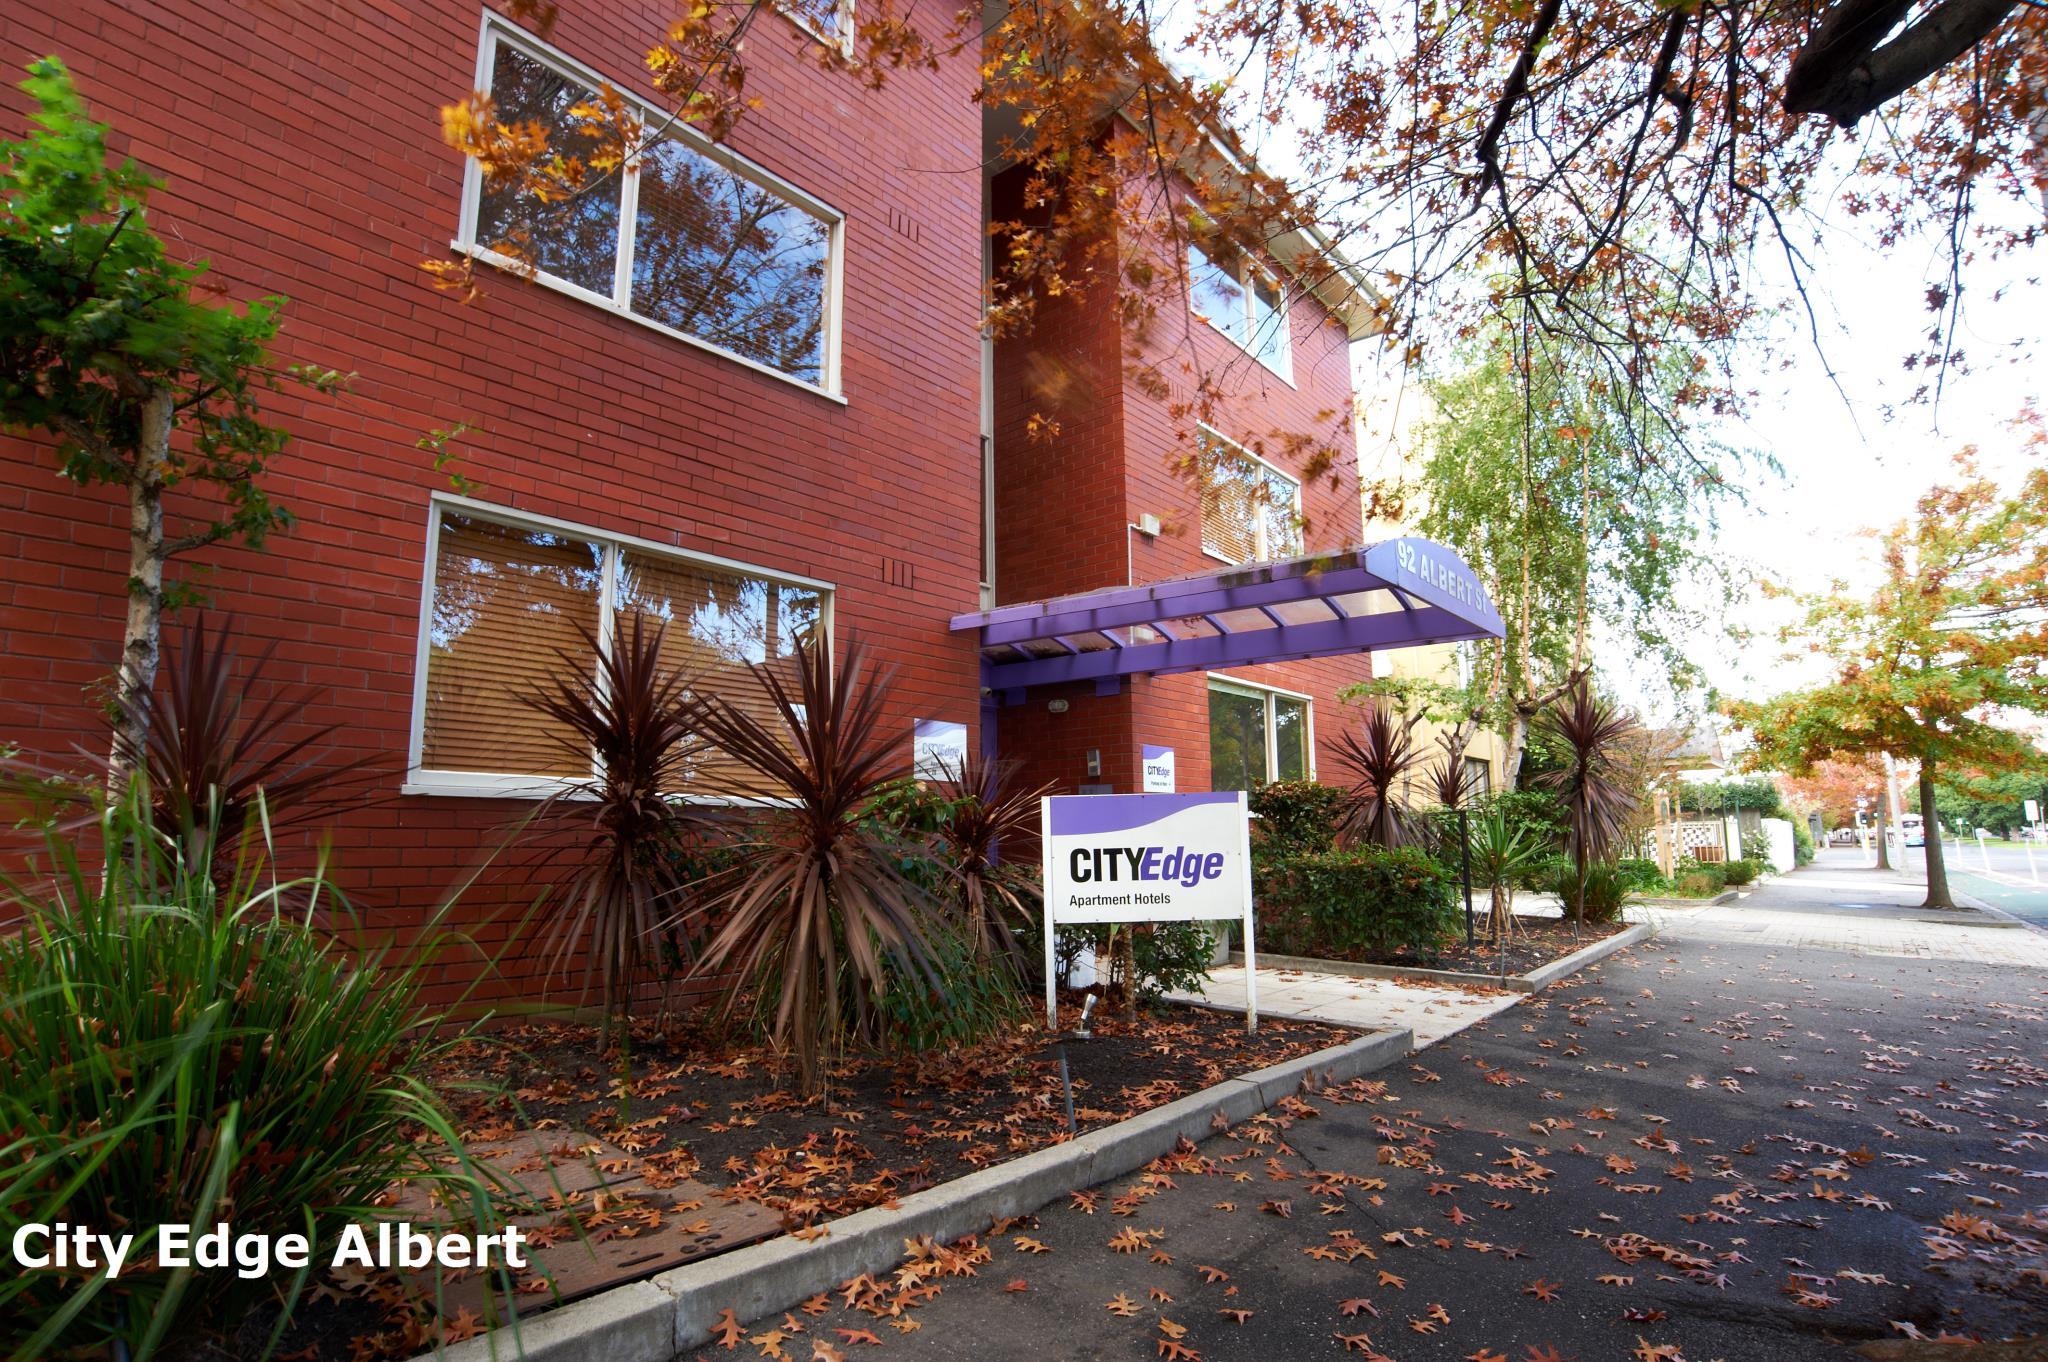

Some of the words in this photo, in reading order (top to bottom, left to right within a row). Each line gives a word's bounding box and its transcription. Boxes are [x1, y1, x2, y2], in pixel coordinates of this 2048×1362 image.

[1397, 540, 1416, 574] 92
[1420, 554, 1472, 606] ALBERT
[1070, 846, 1224, 888] CITYEdge
[1069, 894, 1131, 908] Apartment
[1134, 892, 1171, 905] Hotels
